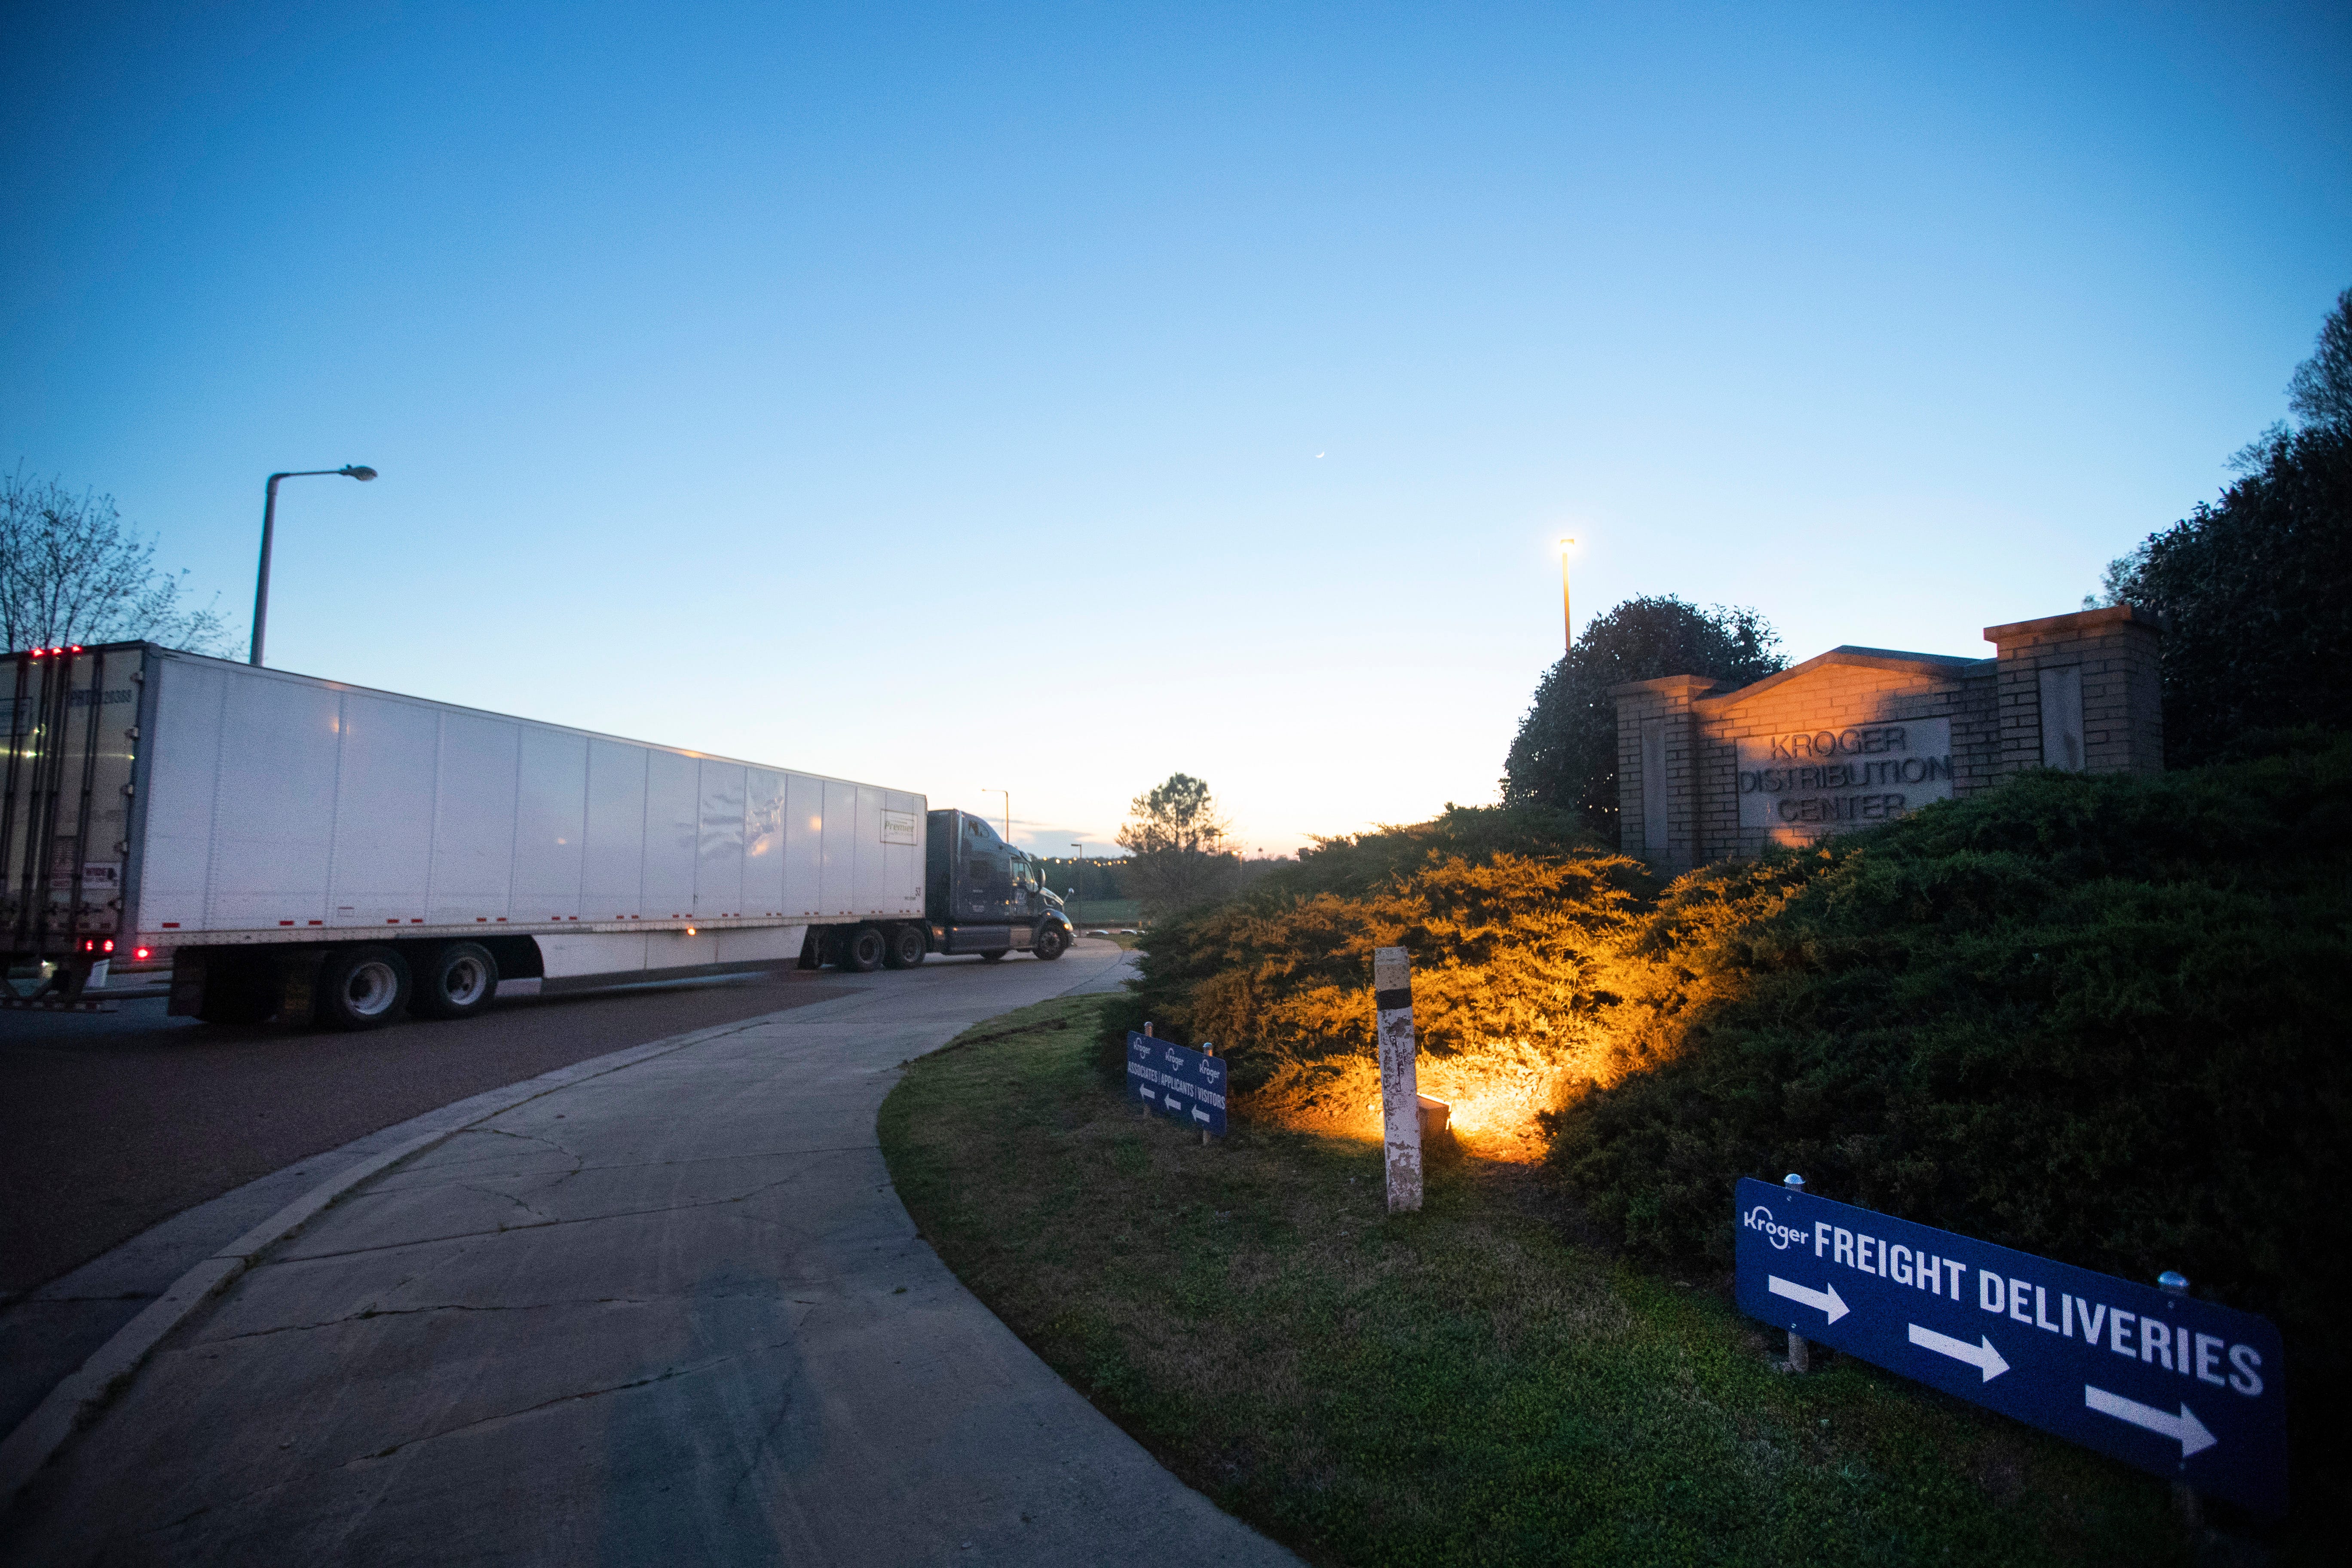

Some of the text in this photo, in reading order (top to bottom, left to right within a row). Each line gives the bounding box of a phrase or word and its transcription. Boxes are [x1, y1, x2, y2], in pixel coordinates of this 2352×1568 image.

[1770, 726, 1906, 760] KROGER
[1739, 755, 1953, 793] DISTRIBUTION
[1778, 793, 1906, 821] CENTER
[1133, 1037, 1151, 1059] Kroger
[1165, 1047, 1184, 1071] Kroger
[1128, 1061, 1225, 1110] ASSOCIATES APPLICANTS VISITORS
[1199, 1059, 1220, 1084] Kroger
[1744, 1206, 1809, 1250] Kroger
[1815, 1221, 2264, 1397] FREIGHT DELIVERIES
